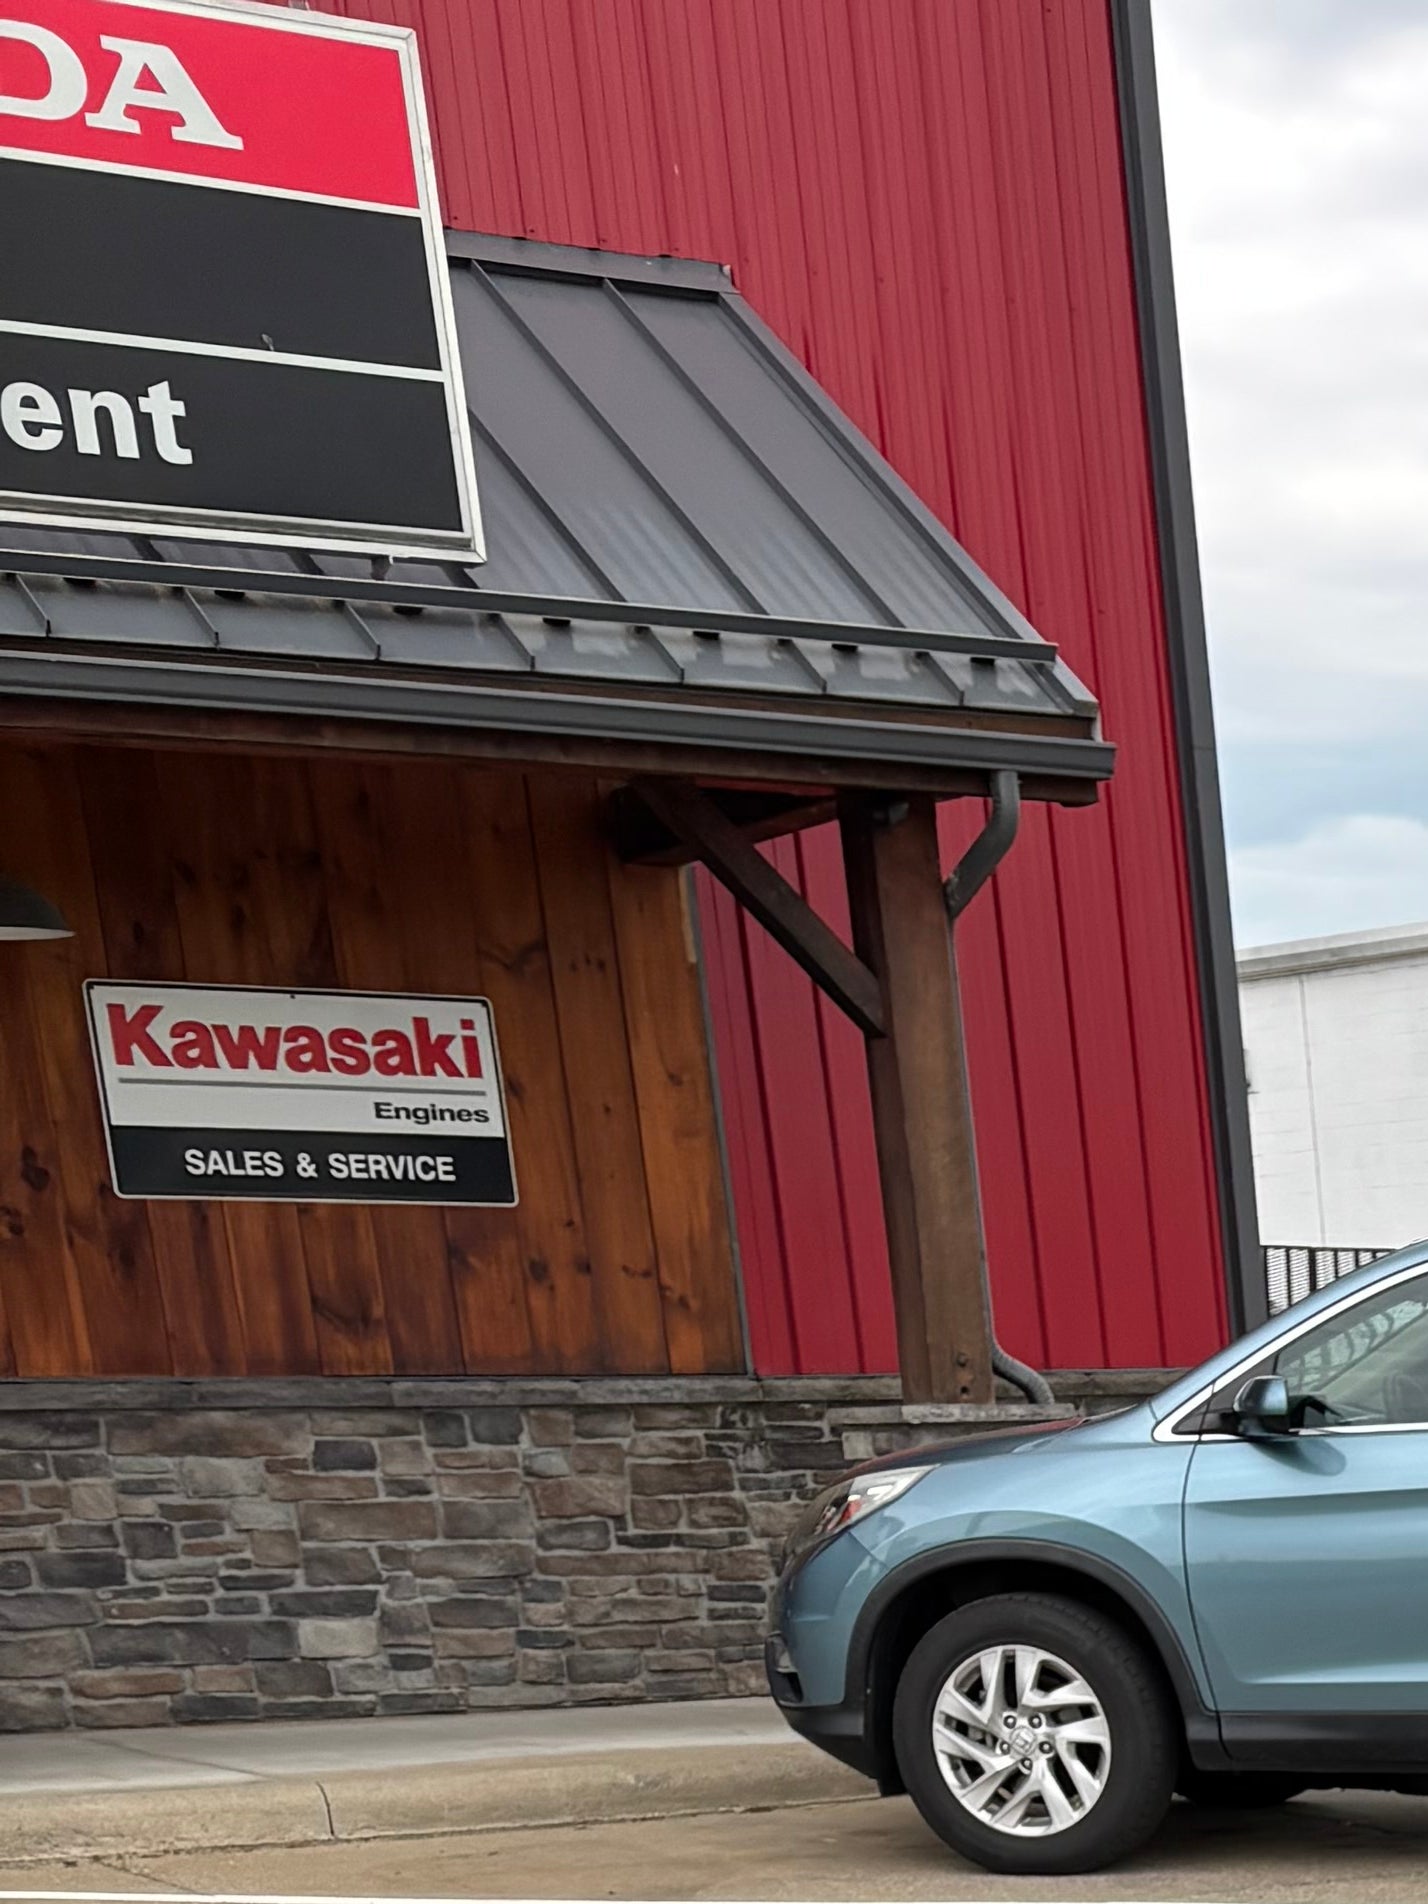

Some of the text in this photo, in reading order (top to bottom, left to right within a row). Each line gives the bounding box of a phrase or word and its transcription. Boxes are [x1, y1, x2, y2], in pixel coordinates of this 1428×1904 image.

[1, 380, 193, 465] ent
[106, 1003, 483, 1079] Kawasaki
[374, 1102, 490, 1124] Engines
[184, 1148, 456, 1182] SALES & SERVICE
